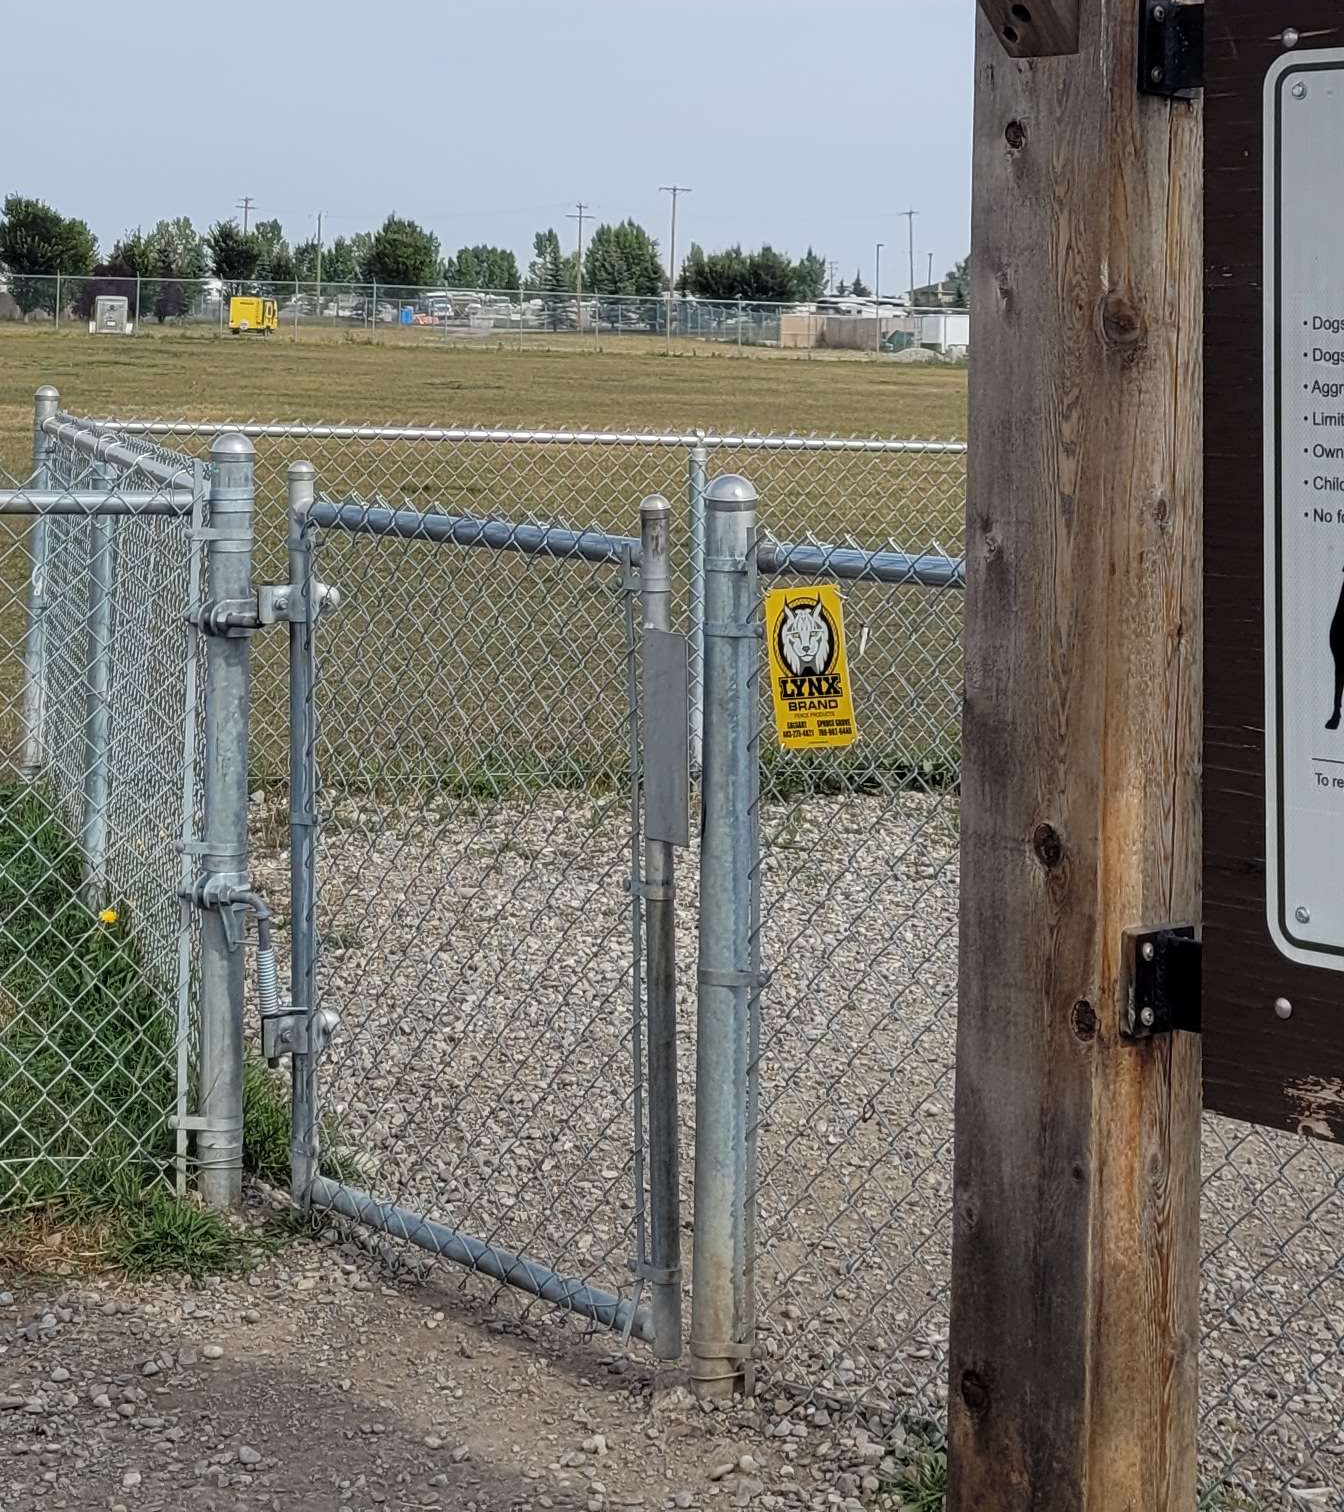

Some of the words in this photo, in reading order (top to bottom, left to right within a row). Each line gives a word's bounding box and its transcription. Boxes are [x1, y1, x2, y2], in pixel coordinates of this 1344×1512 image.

[1313, 508, 1333, 523] No
[780, 676, 842, 698] LYNX
[788, 699, 838, 712] BRAND
[1314, 772, 1329, 787] To
